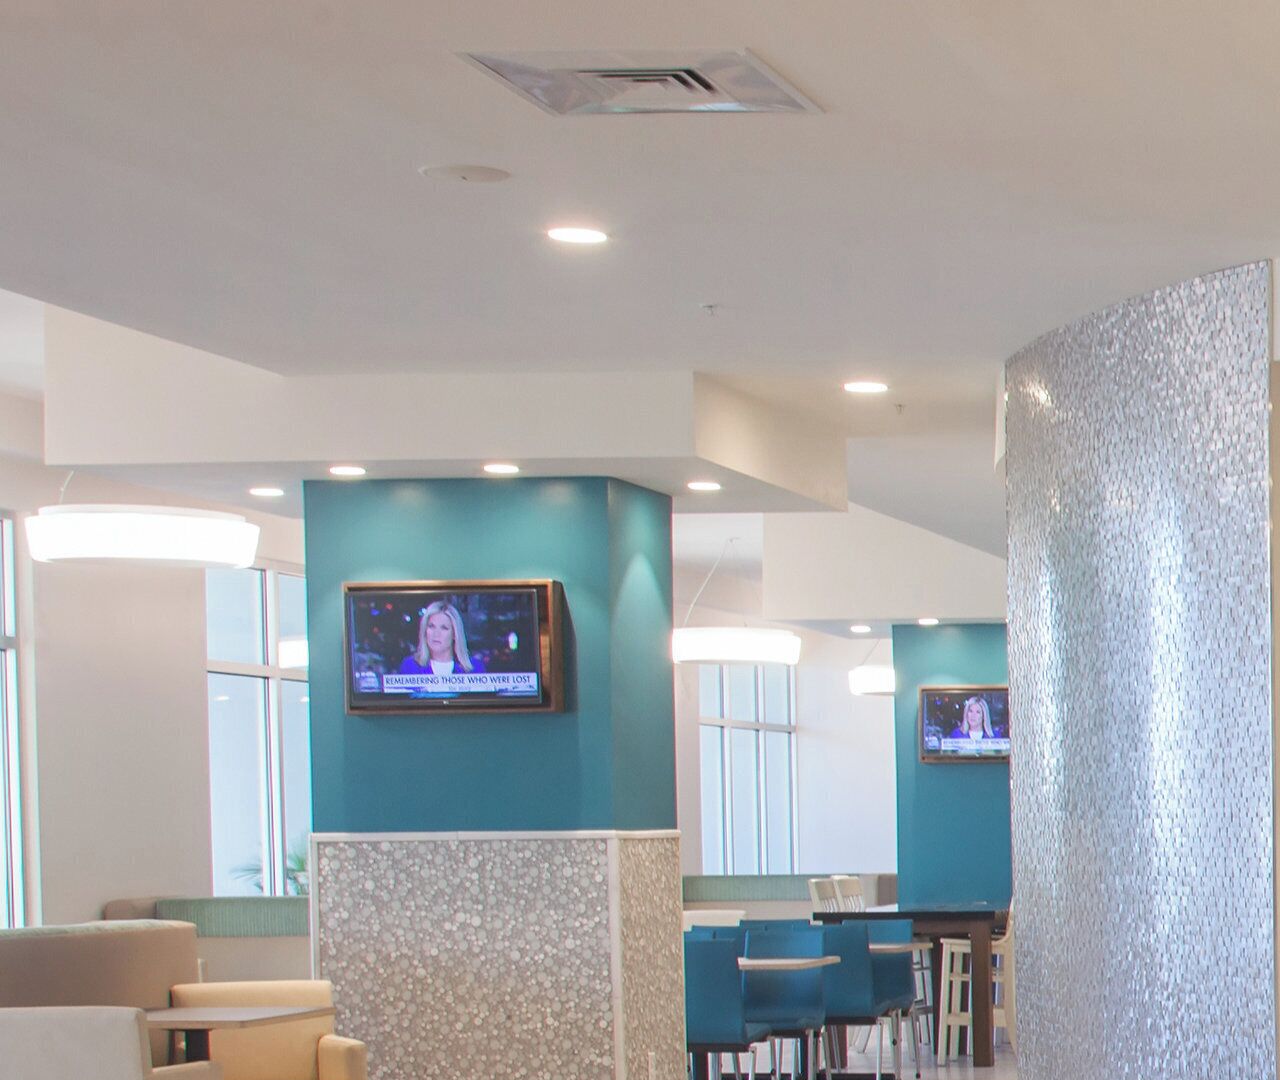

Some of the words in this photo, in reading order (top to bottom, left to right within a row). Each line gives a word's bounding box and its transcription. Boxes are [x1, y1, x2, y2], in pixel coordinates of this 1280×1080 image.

[385, 677, 439, 685] REMEMBERING
[441, 676, 465, 685] THOSE
[468, 676, 488, 684] WHO
[490, 675, 510, 684] WERE
[512, 675, 530, 683] LOST
